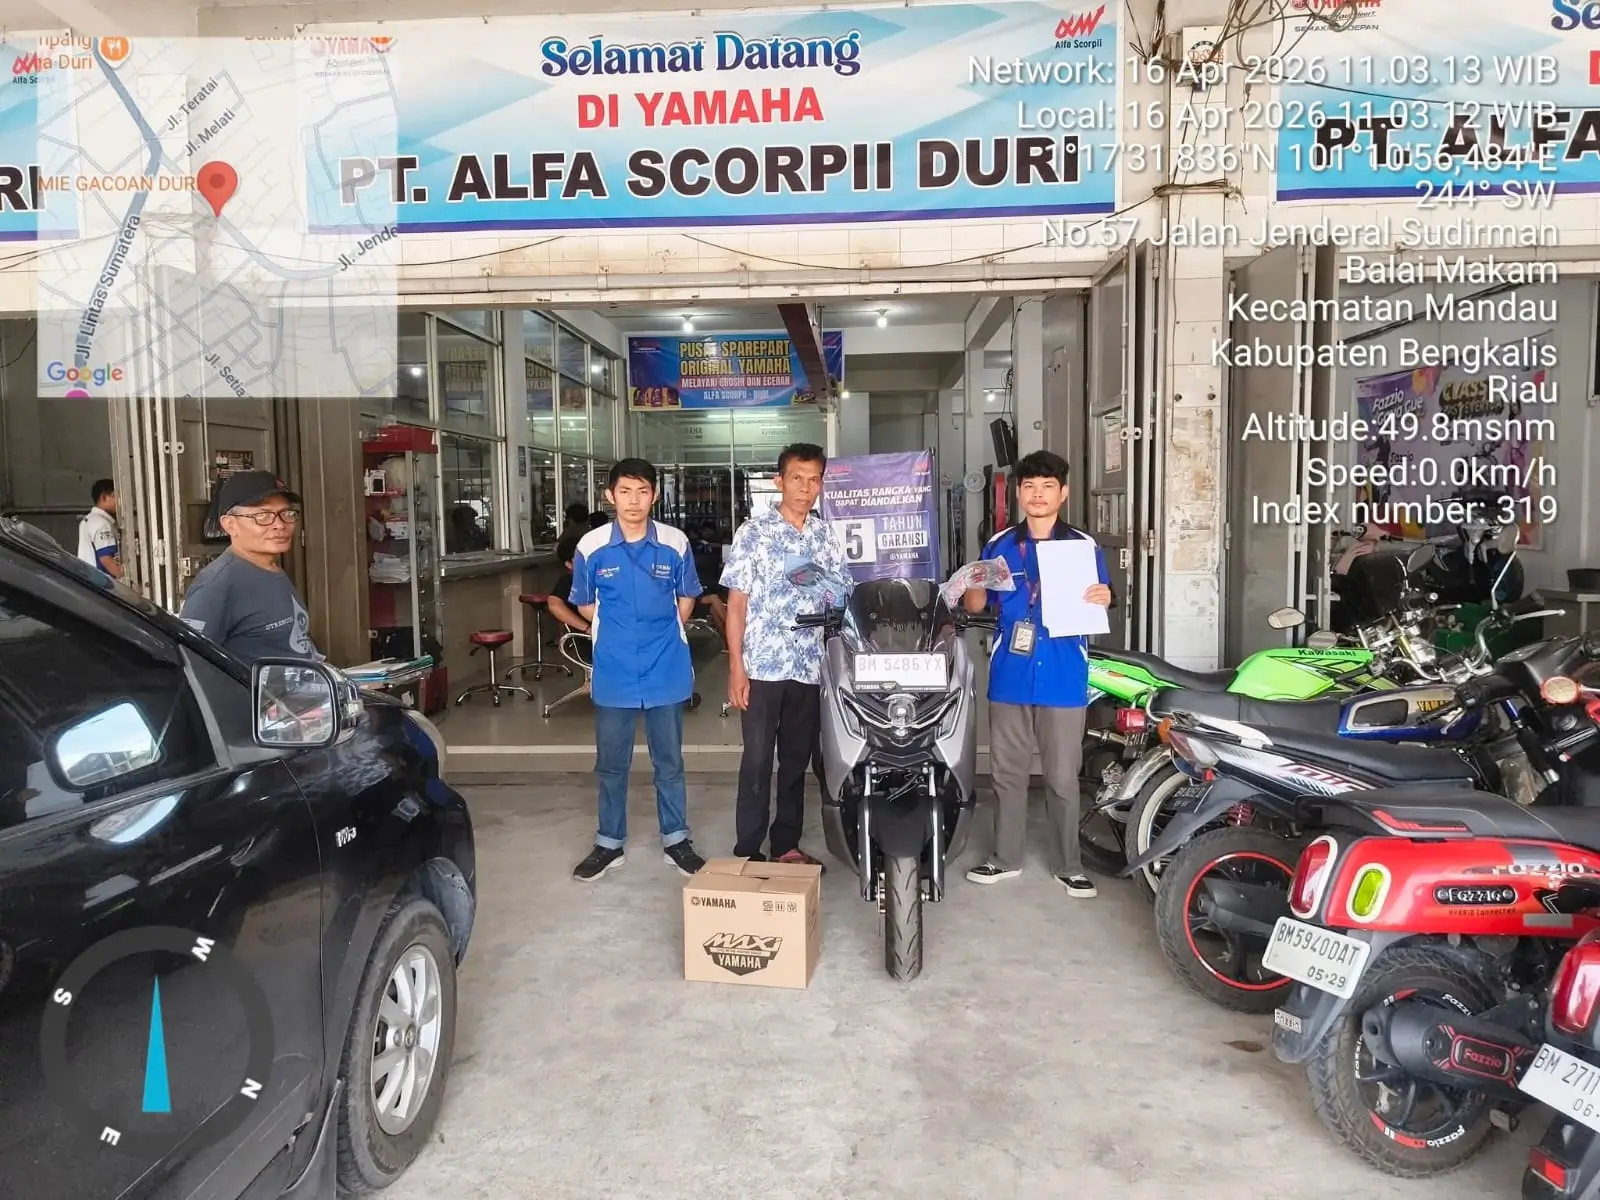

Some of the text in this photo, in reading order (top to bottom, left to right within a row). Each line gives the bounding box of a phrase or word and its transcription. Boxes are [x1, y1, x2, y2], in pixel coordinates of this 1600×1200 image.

[1055, 38, 1102, 48] Alfa Scorpii
[541, 31, 861, 76] Selamat Datang
[578, 87, 824, 128] DI YAMAHA
[341, 136, 1079, 203] PT. ALFA SCORPII DURI
[722, 340, 790, 356] SPAREPART
[739, 358, 790, 374] YAMAHA
[824, 488, 869, 500] KUALITAS
[872, 486, 911, 497] RANGKA
[860, 494, 922, 507] DIANDALKAN
[882, 514, 922, 531] TAHUN
[846, 523, 862, 560] 5
[882, 532, 924, 547] GARANSI
[858, 657, 876, 672] BM
[701, 897, 736, 909] YAMAHA
[718, 953, 762, 969] YAMAHA
